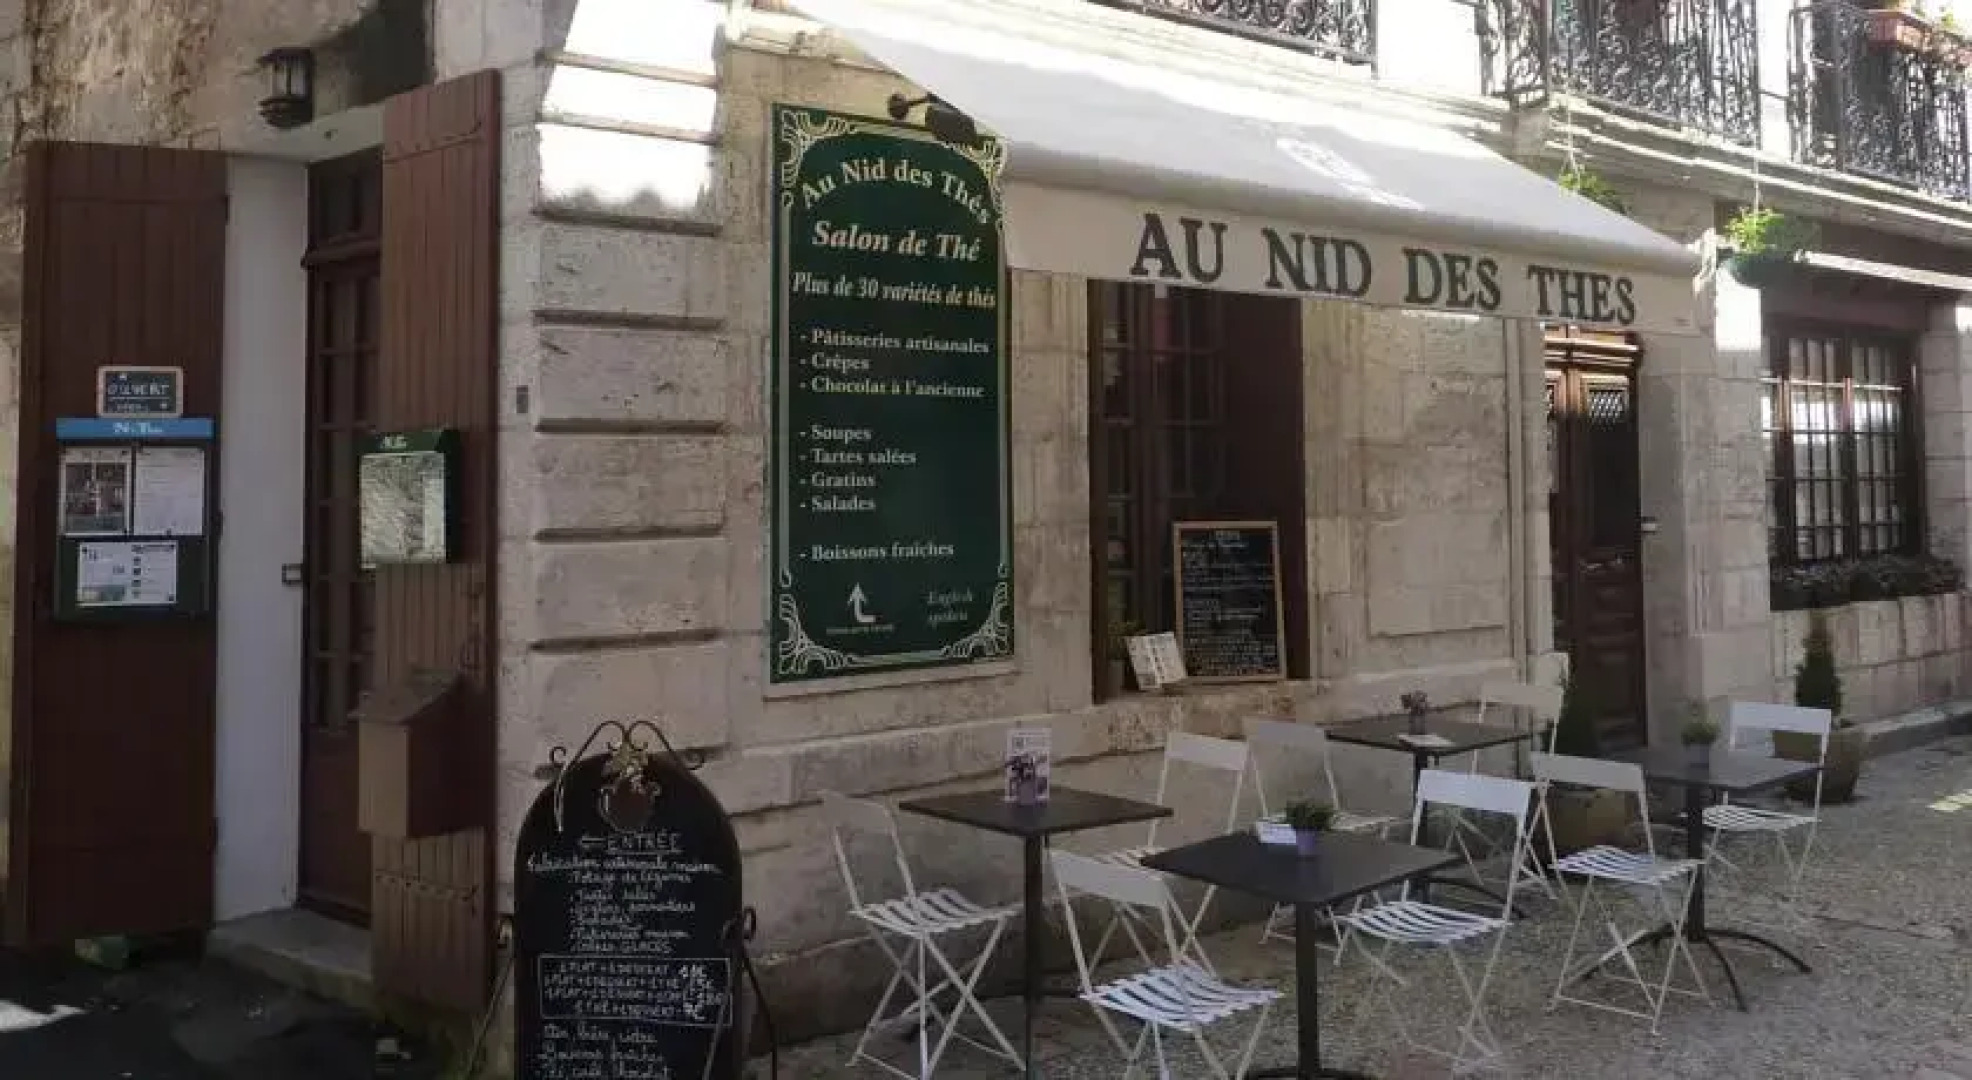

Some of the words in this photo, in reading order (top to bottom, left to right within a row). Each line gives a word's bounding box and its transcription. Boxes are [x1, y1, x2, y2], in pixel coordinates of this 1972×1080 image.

[802, 174, 837, 209] Au
[841, 158, 886, 184] Nid
[894, 160, 932, 188] des
[940, 171, 991, 224] Thés
[812, 220, 890, 252] Salon
[898, 230, 928, 256] de
[936, 233, 981, 262] Thé
[1129, 213, 1228, 284] AU
[1262, 227, 1373, 299] NID
[1402, 248, 1502, 311] DES
[1526, 264, 1637, 327] THES
[792, 271, 830, 294] Plus
[833, 275, 853, 297] de
[859, 278, 878, 299] 30
[882, 281, 941, 304] variétés
[945, 285, 964, 306] de
[966, 289, 996, 309] thés
[811, 328, 900, 348] Pâtisseries
[905, 336, 989, 354] artisanales
[811, 352, 870, 373] Crêpes
[108, 383, 170, 396] OUVERT
[811, 376, 886, 395] Chocolat
[891, 379, 901, 396] à
[905, 379, 985, 398] l'ancienne
[811, 424, 872, 444] Soupes
[811, 448, 864, 464] Tartes
[868, 448, 917, 464] salées
[811, 472, 877, 487] Gratins
[811, 495, 876, 512] Salades
[811, 544, 886, 561] Boissons
[891, 541, 954, 558] fraîches
